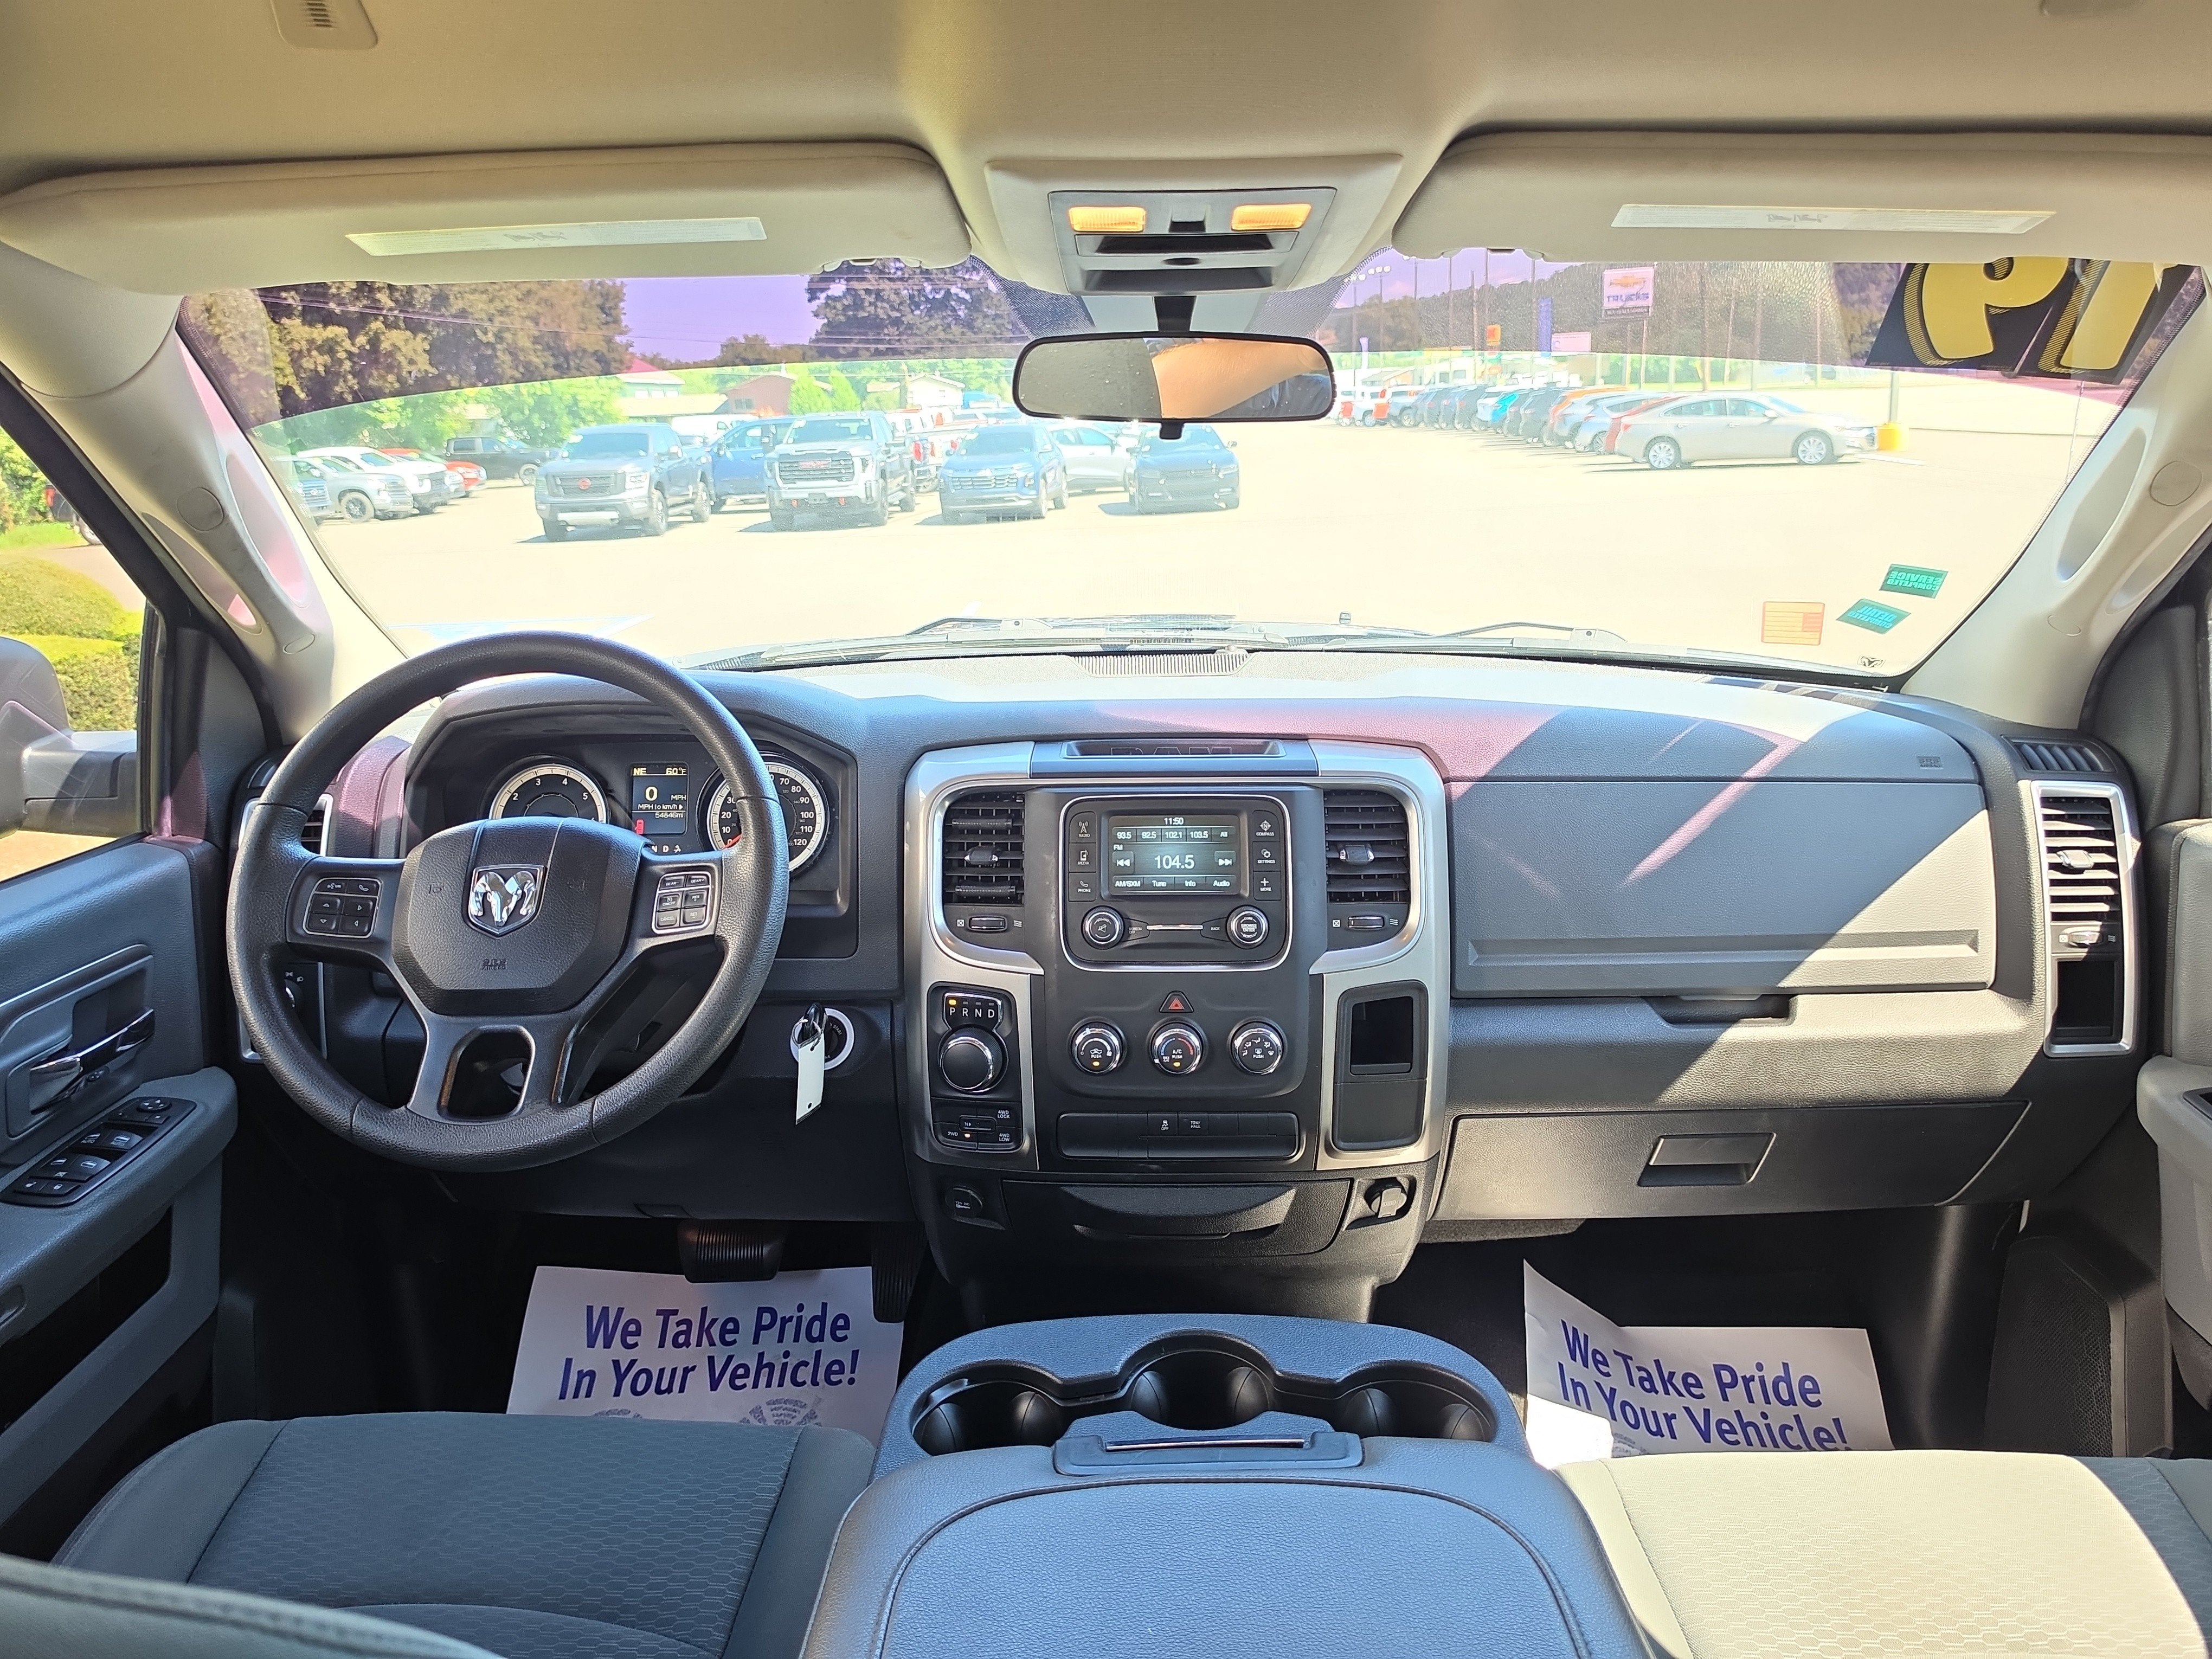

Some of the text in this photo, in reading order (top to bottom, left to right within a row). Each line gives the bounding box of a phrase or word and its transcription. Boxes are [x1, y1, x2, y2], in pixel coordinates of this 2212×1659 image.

[1607, 292, 1649, 303] TRUCKS
[536, 778, 541, 786] 3
[562, 778, 568, 786] 4
[645, 786, 658, 801] 0
[1164, 817, 1184, 825] 11:50
[1154, 854, 1194, 869] 104.5
[949, 1007, 995, 1018] P R N D
[586, 1302, 851, 1349] We Take Pride
[1561, 1319, 1822, 1408] We Take Pride
[558, 1349, 860, 1401] In Your Vehicle!
[1558, 1362, 1852, 1451] In Your Vehicle!
